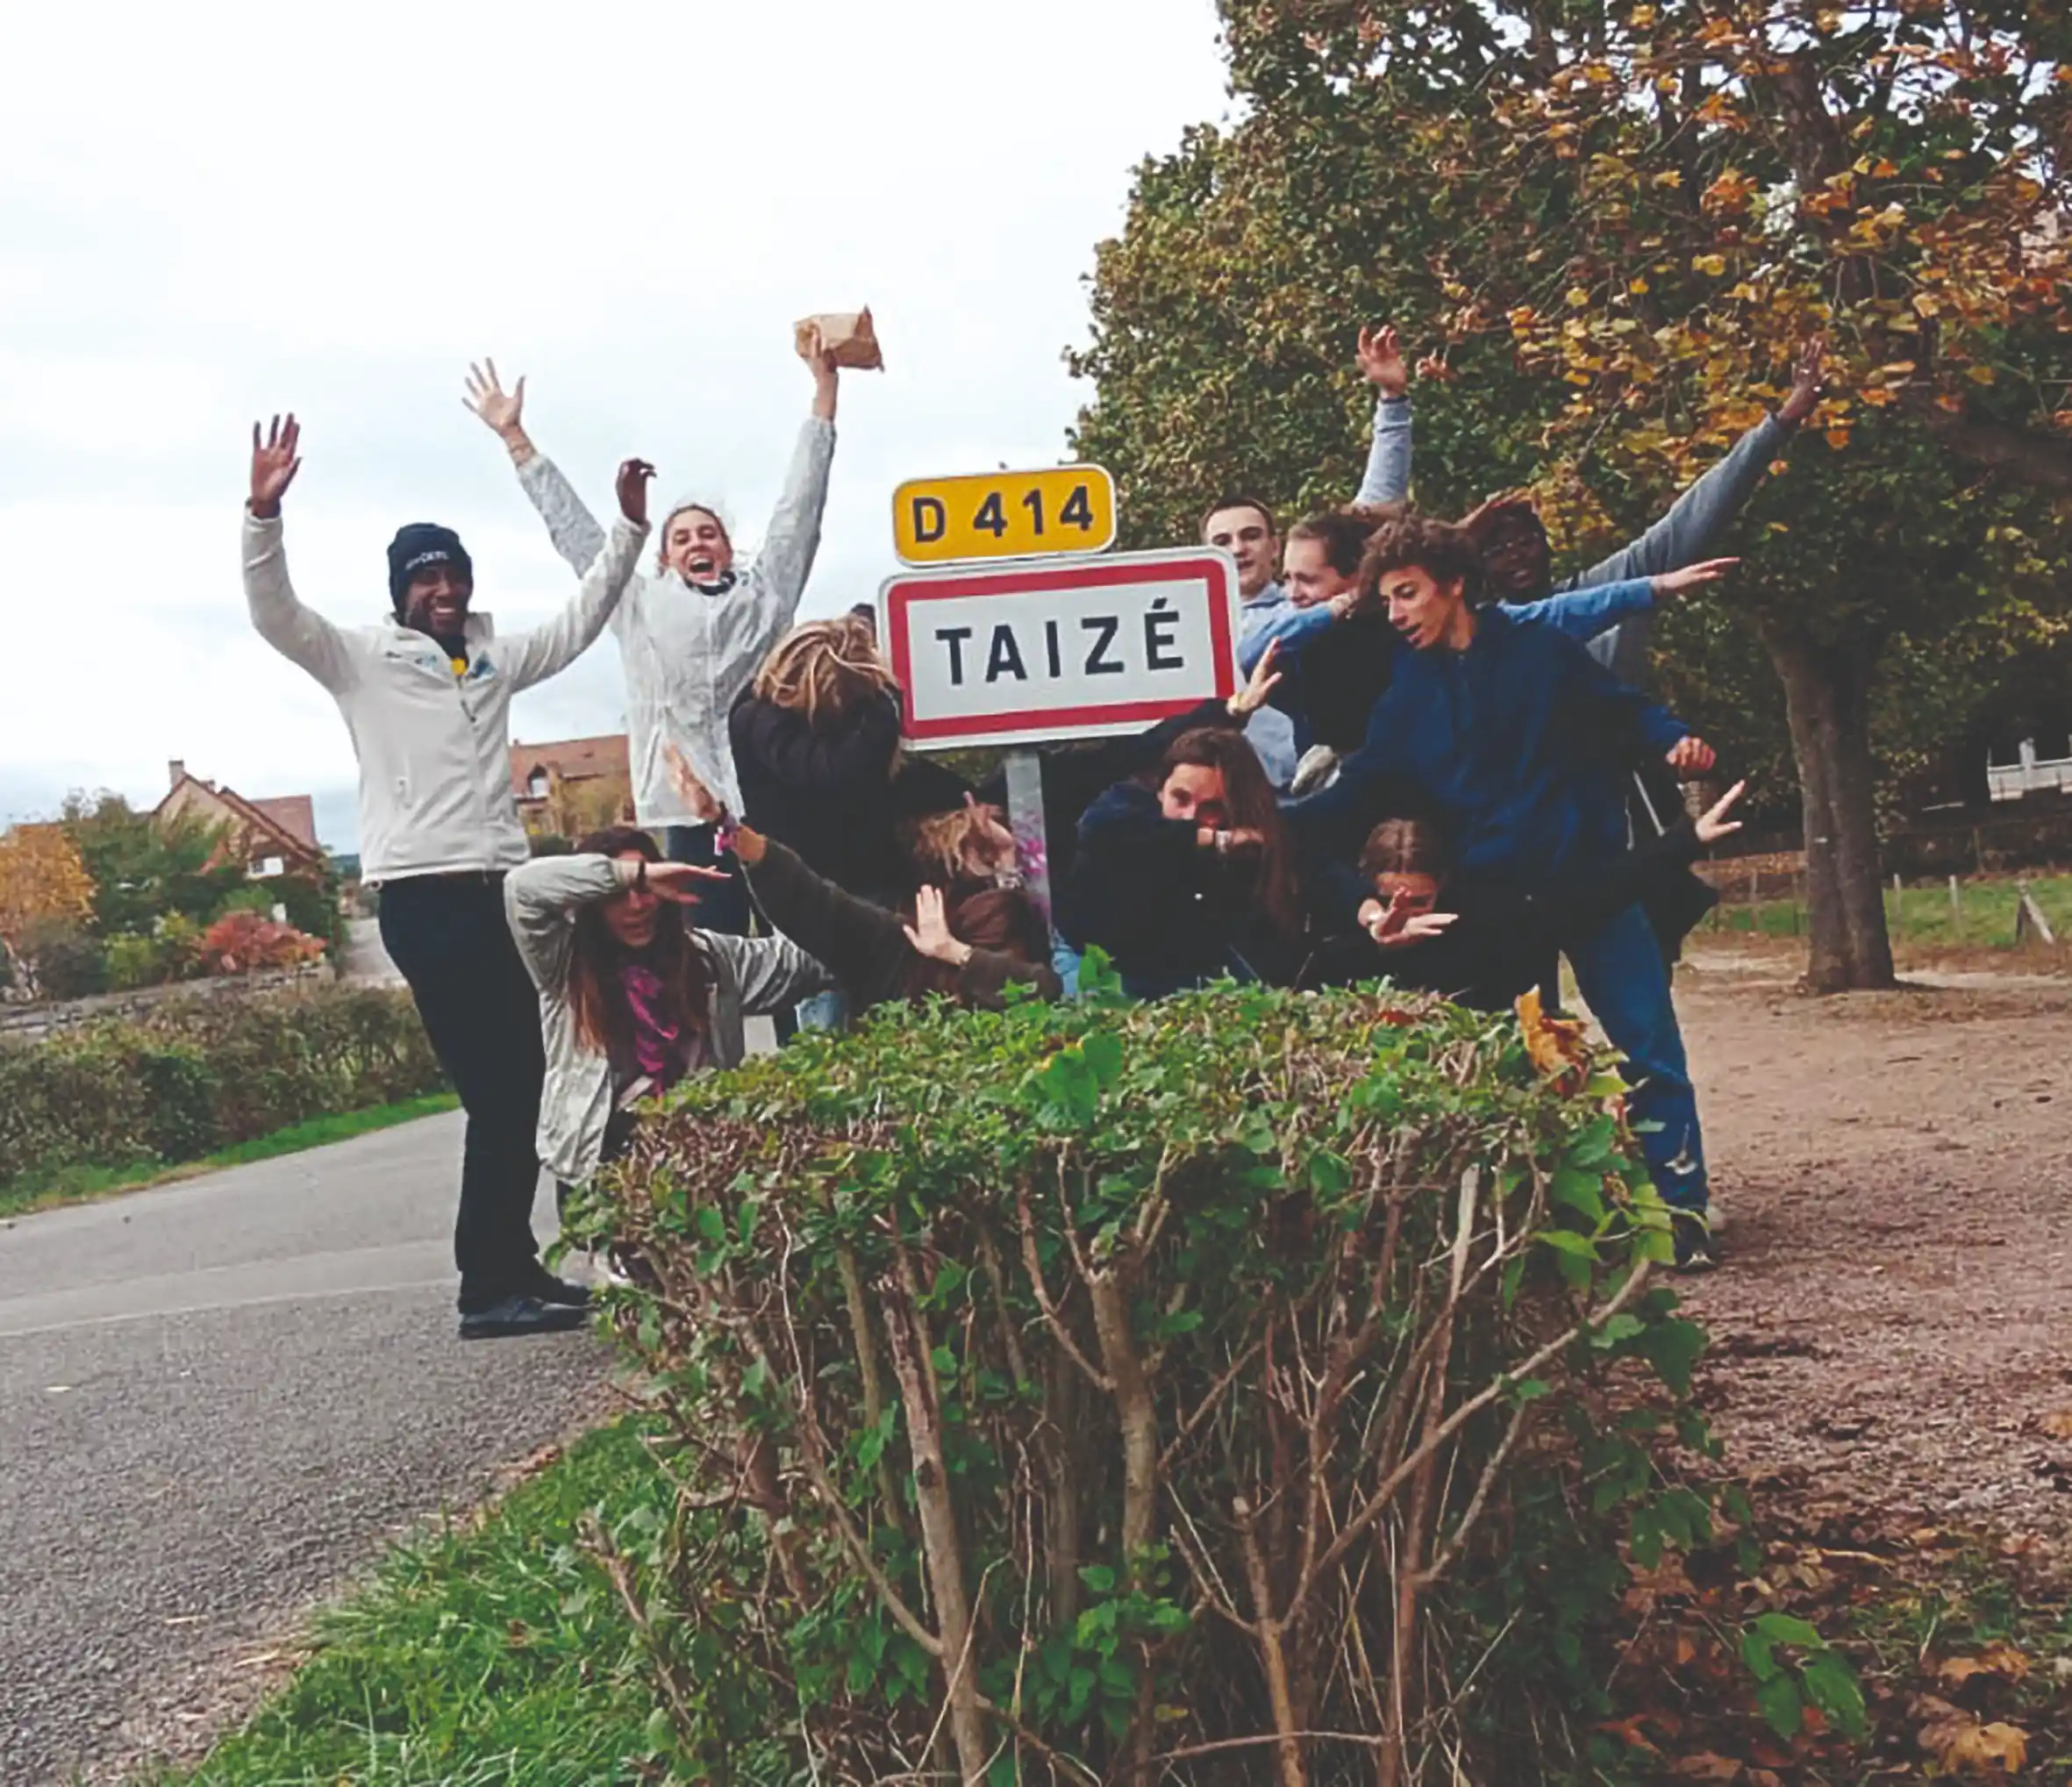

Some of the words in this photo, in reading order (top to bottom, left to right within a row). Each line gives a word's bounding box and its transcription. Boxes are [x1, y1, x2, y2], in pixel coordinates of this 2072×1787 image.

[912, 497, 946, 543] D
[973, 485, 1094, 538] 414
[934, 597, 1185, 685] TAIZÉ
